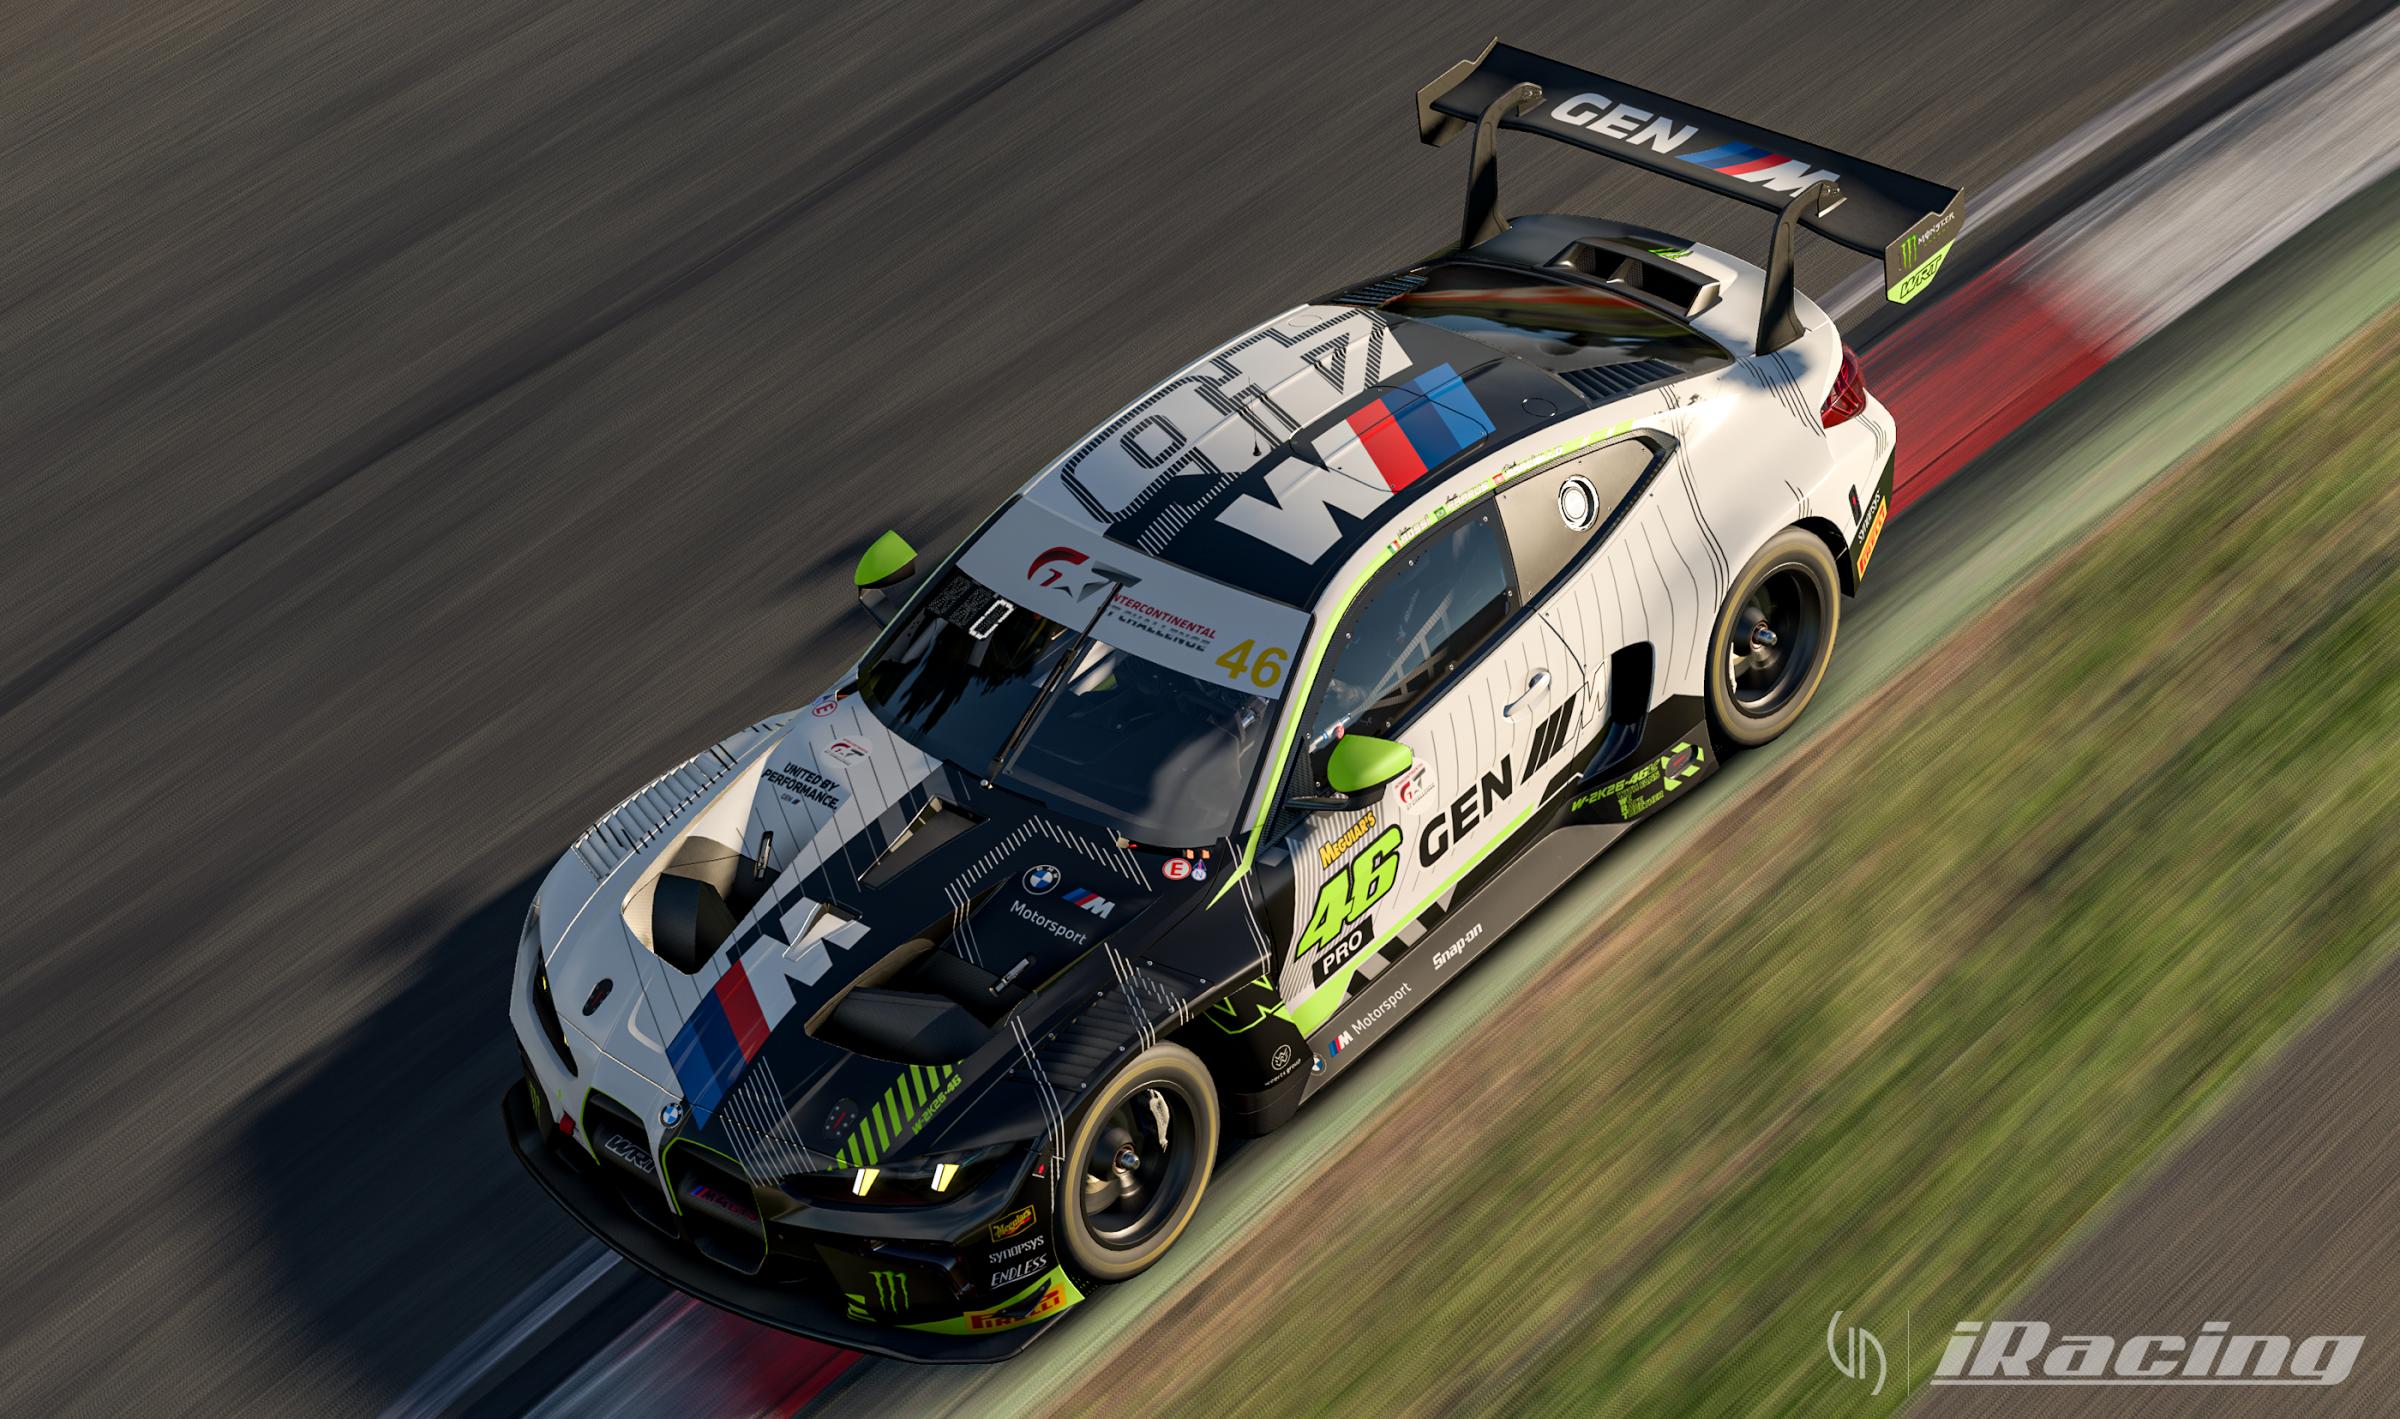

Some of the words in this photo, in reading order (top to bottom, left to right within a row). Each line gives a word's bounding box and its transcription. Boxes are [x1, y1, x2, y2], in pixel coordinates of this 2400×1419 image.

[1550, 92, 1699, 155] GEN
[1900, 253, 1942, 299] WRT
[1111, 592, 1217, 640] NTERCONTINENTAL
[1215, 638, 1289, 689] 46
[761, 768, 840, 810] PERFORMANCE.
[783, 761, 822, 785] UNITED
[819, 778, 840, 792] BY
[1418, 753, 1513, 868] GEN
[1318, 810, 1376, 871] MEGUIAR'S
[1293, 823, 1403, 963] 46
[1010, 900, 1087, 945] Motorsport
[1432, 922, 1484, 971] Snap-on
[1322, 930, 1363, 976] PRO
[1351, 982, 1412, 1035] Motorsport
[991, 1253, 1047, 1288] ENDLESS
